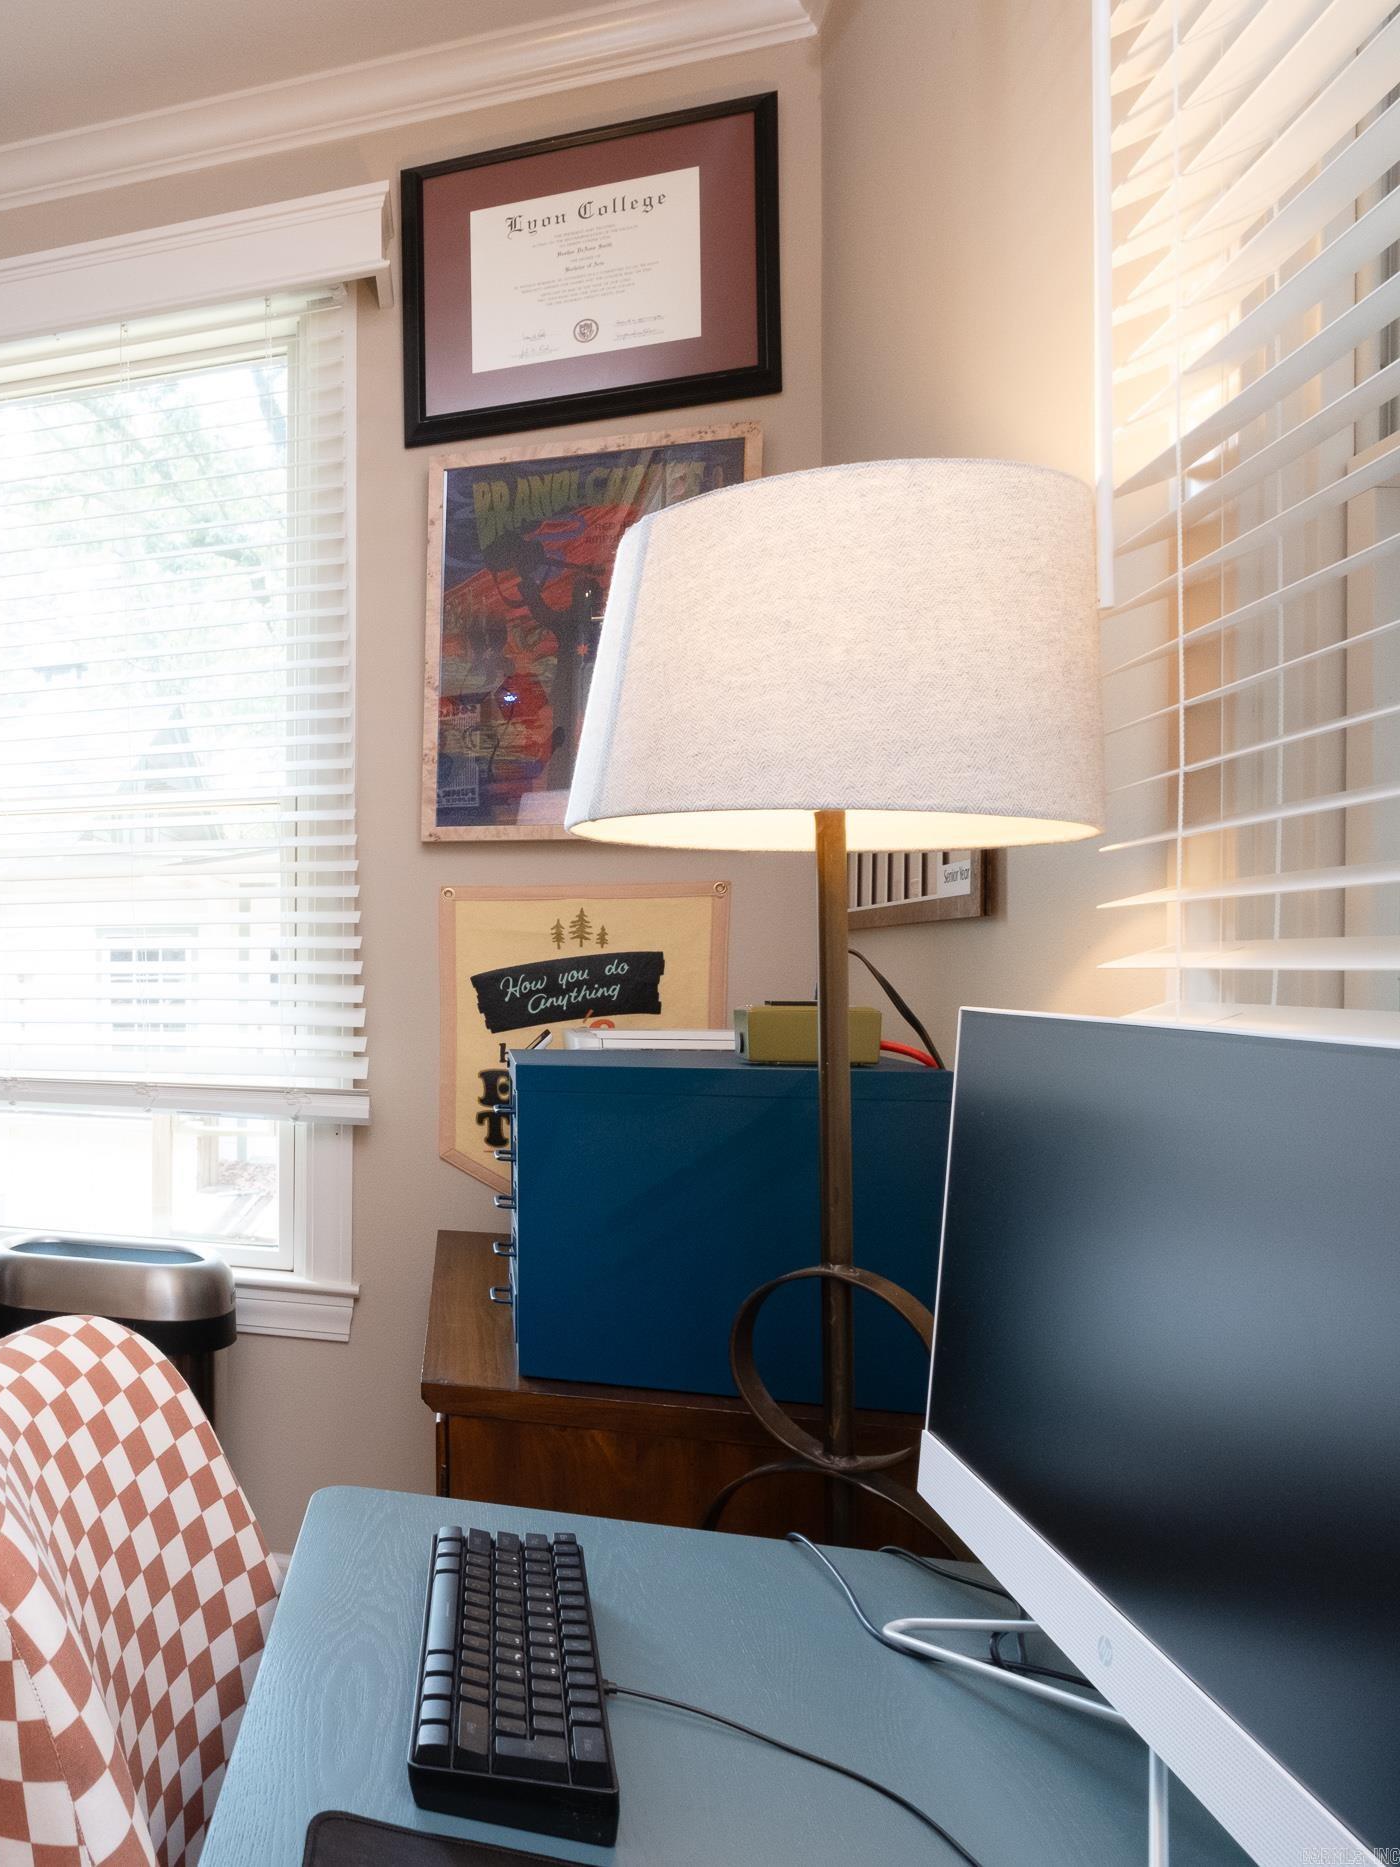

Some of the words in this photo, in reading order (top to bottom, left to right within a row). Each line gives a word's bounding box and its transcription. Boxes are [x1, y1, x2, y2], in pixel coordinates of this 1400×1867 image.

[505, 213, 566, 240] Lyon
[577, 193, 667, 220] College
[500, 973, 547, 1002] How
[558, 969, 590, 989] you
[604, 959, 630, 975] do
